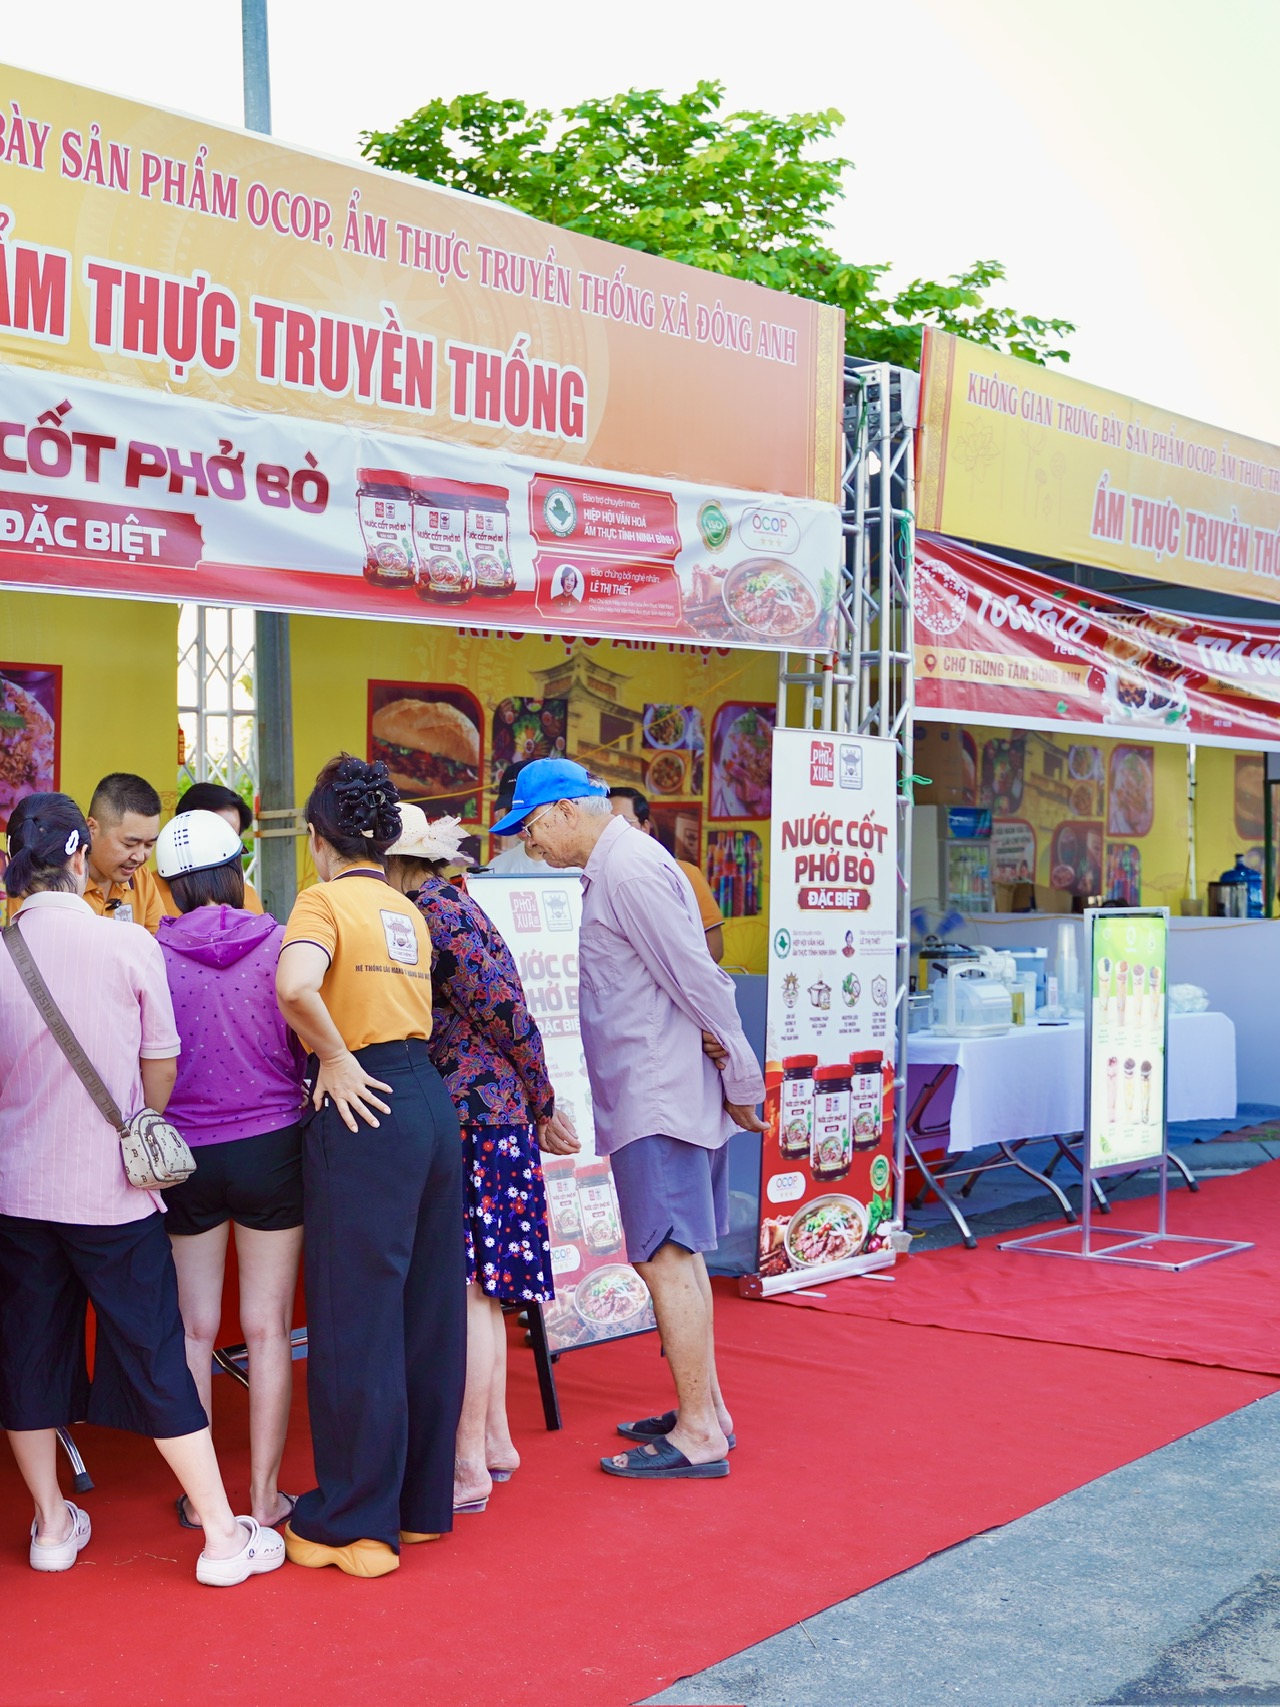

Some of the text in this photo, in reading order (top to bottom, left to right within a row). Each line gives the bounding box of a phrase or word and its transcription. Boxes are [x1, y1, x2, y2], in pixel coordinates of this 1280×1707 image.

[61, 123, 130, 192] SẢN
[141, 144, 238, 220] PHẨM
[248, 183, 334, 248] OCOP,
[342, 190, 387, 261] ẨM
[396, 223, 470, 284] THỰC
[478, 244, 572, 307] TRUYỀN
[579, 264, 655, 330] THỐNG
[661, 304, 691, 338] XÃ
[696, 304, 753, 354] ĐÔNG
[758, 329, 797, 366] ANH
[87, 263, 236, 376] THỰC
[254, 307, 432, 412] TRUYỀN
[448, 336, 584, 439] THỐNG
[968, 373, 1017, 415] KHÔNG
[1021, 390, 1053, 426] GIAN
[1057, 402, 1098, 439] TRƯNG
[1102, 412, 1124, 447] BÀY
[1126, 420, 1149, 454] SẢN
[1152, 425, 1184, 466] PHẨM
[124, 439, 246, 501] PHỞ
[256, 451, 329, 514] BÒ
[86, 514, 167, 561] BIỆT
[584, 508, 646, 527] HIỆP HỘI VĂN HOÁ
[584, 522, 674, 544] ẨM THỰC TỈNH NINH BÌNH
[1092, 473, 1249, 568] ẨM THỰC TRUYỀN
[590, 580, 632, 596] LÊ THỊ THIẾT
[944, 656, 966, 676] CHỢ
[970, 659, 1004, 677] TRUNG
[1008, 660, 1028, 679] TÂM
[782, 809, 887, 853] NƯỚC CỐT
[795, 848, 874, 885] PHỞ BÒ
[808, 889, 859, 909] ĐẶC BIỆT
